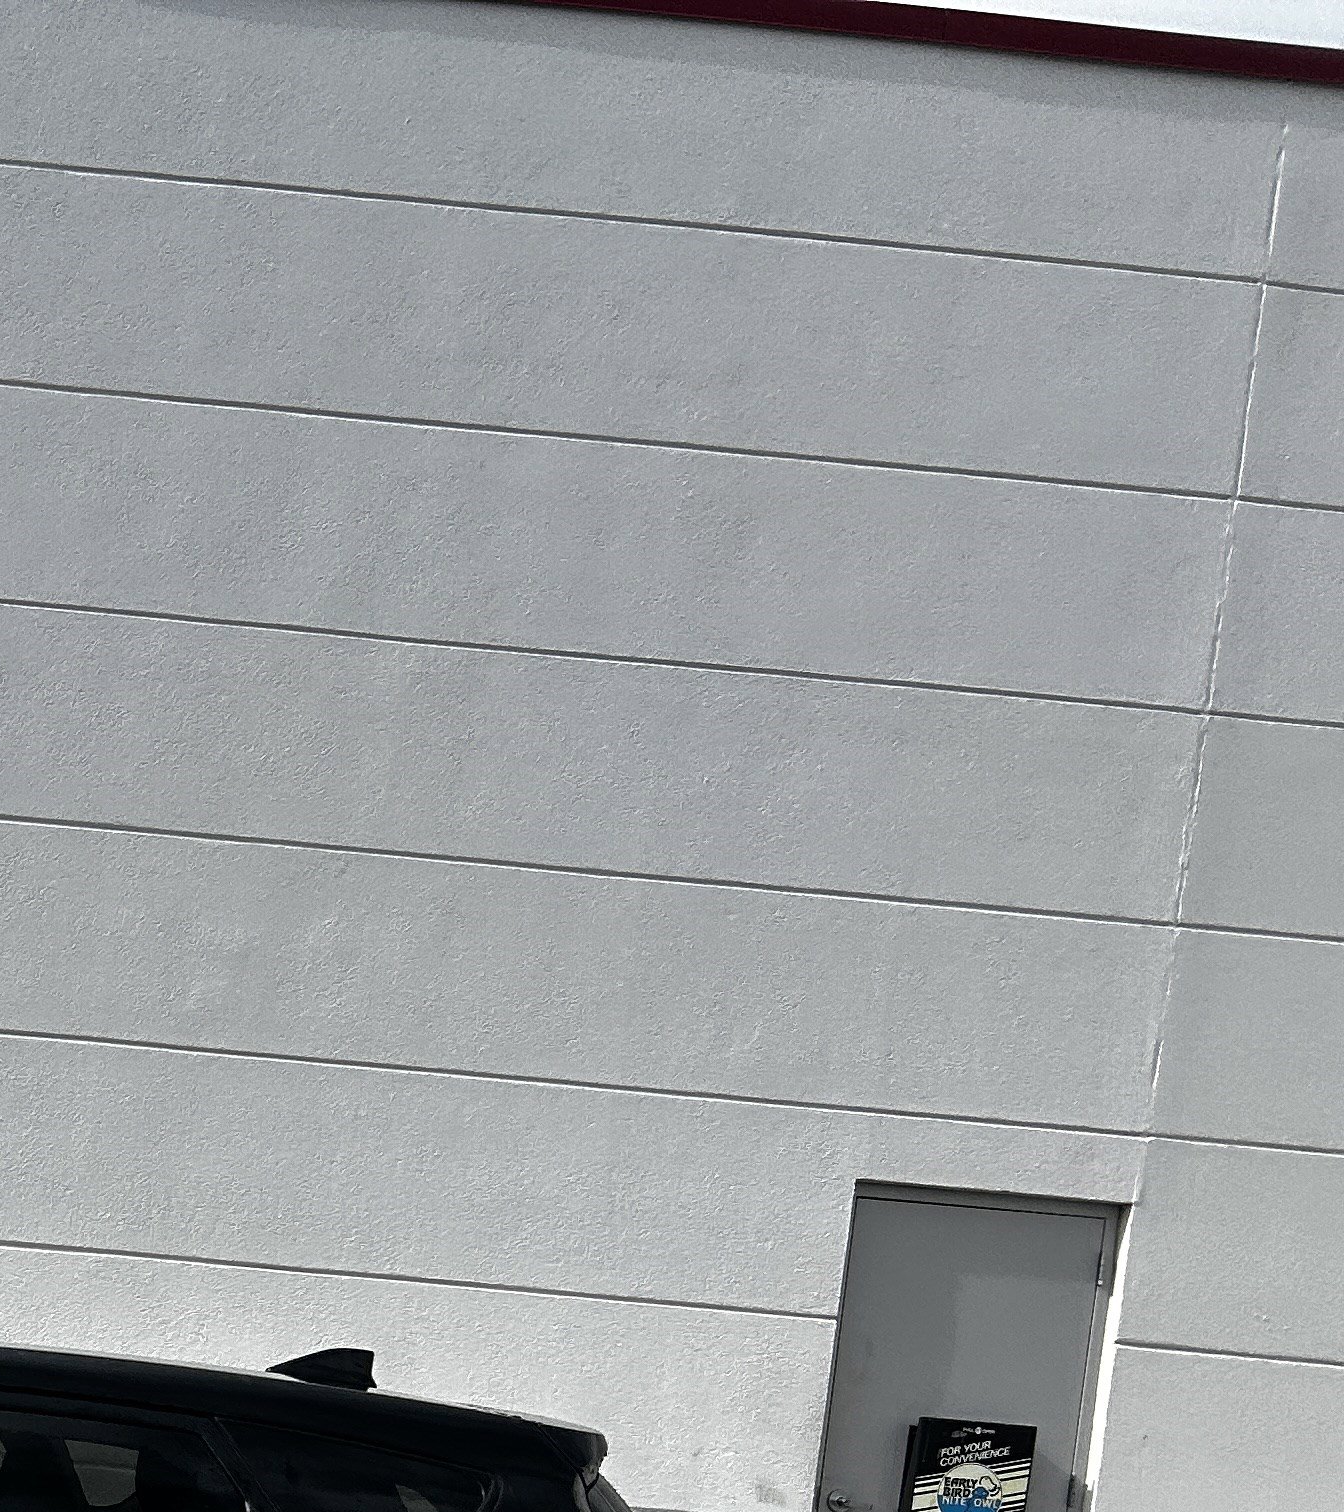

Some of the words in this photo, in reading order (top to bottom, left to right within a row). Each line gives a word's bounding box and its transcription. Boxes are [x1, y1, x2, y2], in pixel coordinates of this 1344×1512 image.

[941, 1446, 961, 1457] FOR
[964, 1441, 991, 1452] YOUR
[940, 1447, 1010, 1466] CONVENIENCE
[944, 1477, 977, 1488] EARLY
[943, 1488, 970, 1497] BIRD
[942, 1497, 967, 1506] NITE
[974, 1499, 998, 1508] OWL
